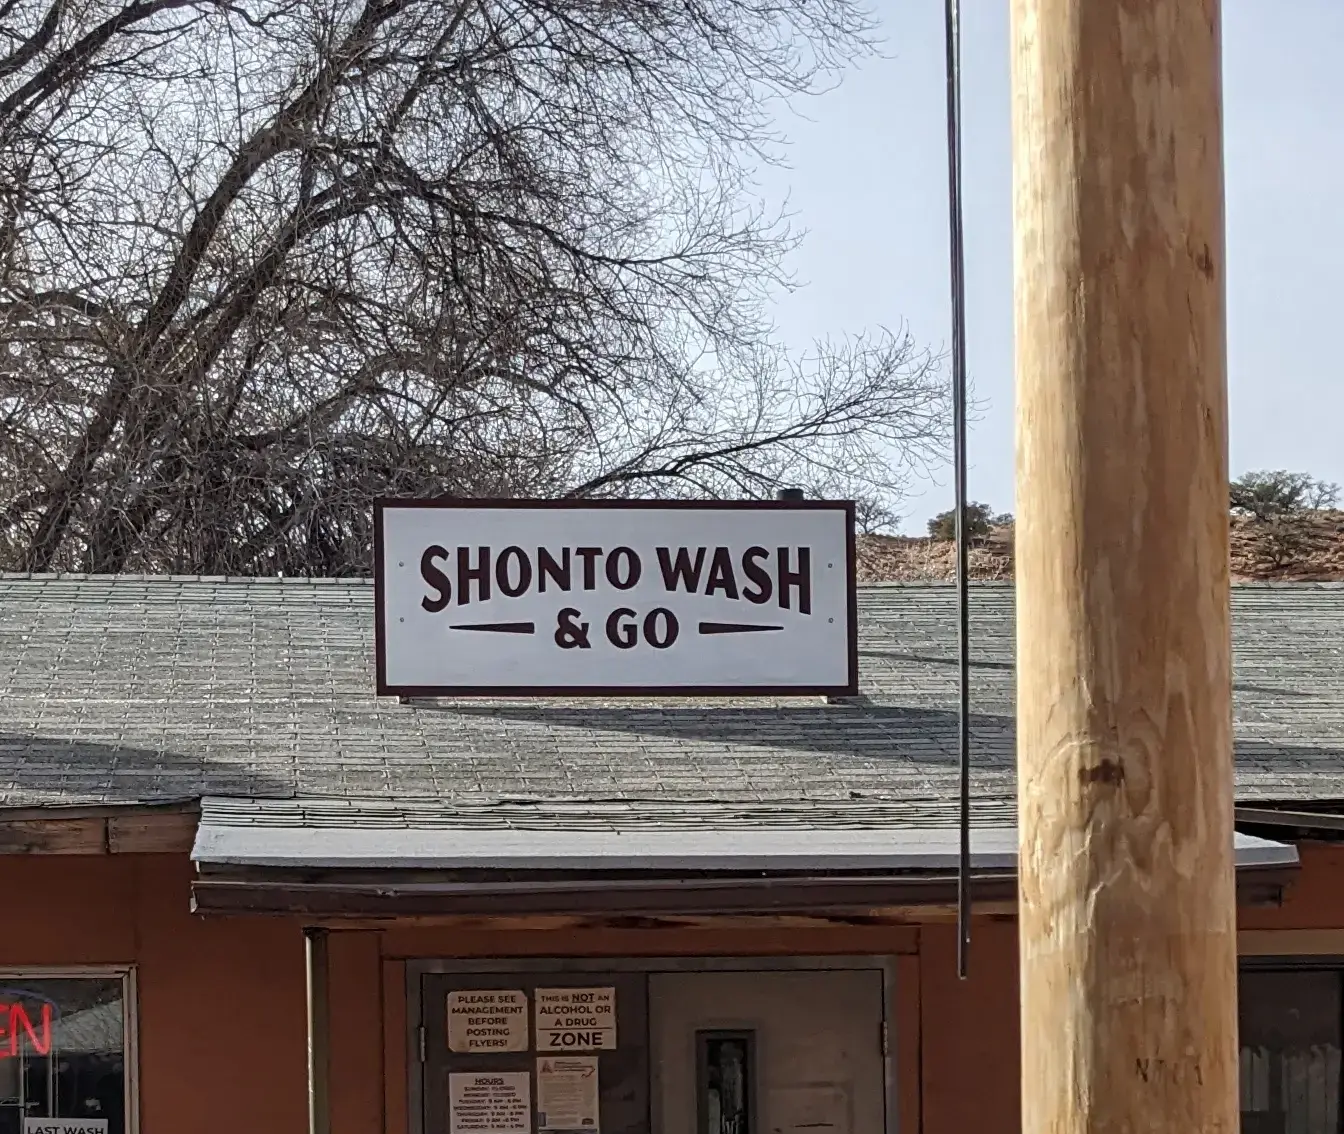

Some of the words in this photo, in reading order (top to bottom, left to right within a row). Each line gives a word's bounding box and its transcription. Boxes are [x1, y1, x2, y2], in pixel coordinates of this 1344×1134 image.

[420, 545, 642, 613] SHONTO
[656, 546, 811, 615] WASH
[554, 607, 591, 649] &
[606, 607, 679, 649] GO
[458, 995, 495, 1003] PLEASE
[498, 995, 516, 1003] SEE
[572, 993, 595, 1002] NOT
[451, 1006, 524, 1014] MANAGEMENT
[539, 1006, 593, 1015] ALCOHOL
[595, 1005, 611, 1014] OR
[468, 1017, 508, 1025] BEFORE
[554, 1018, 562, 1026] A
[565, 1017, 597, 1026] DRUG
[466, 1028, 510, 1036] POSTING
[469, 1039, 508, 1047] FLYERS!
[549, 1032, 603, 1047] ZONE
